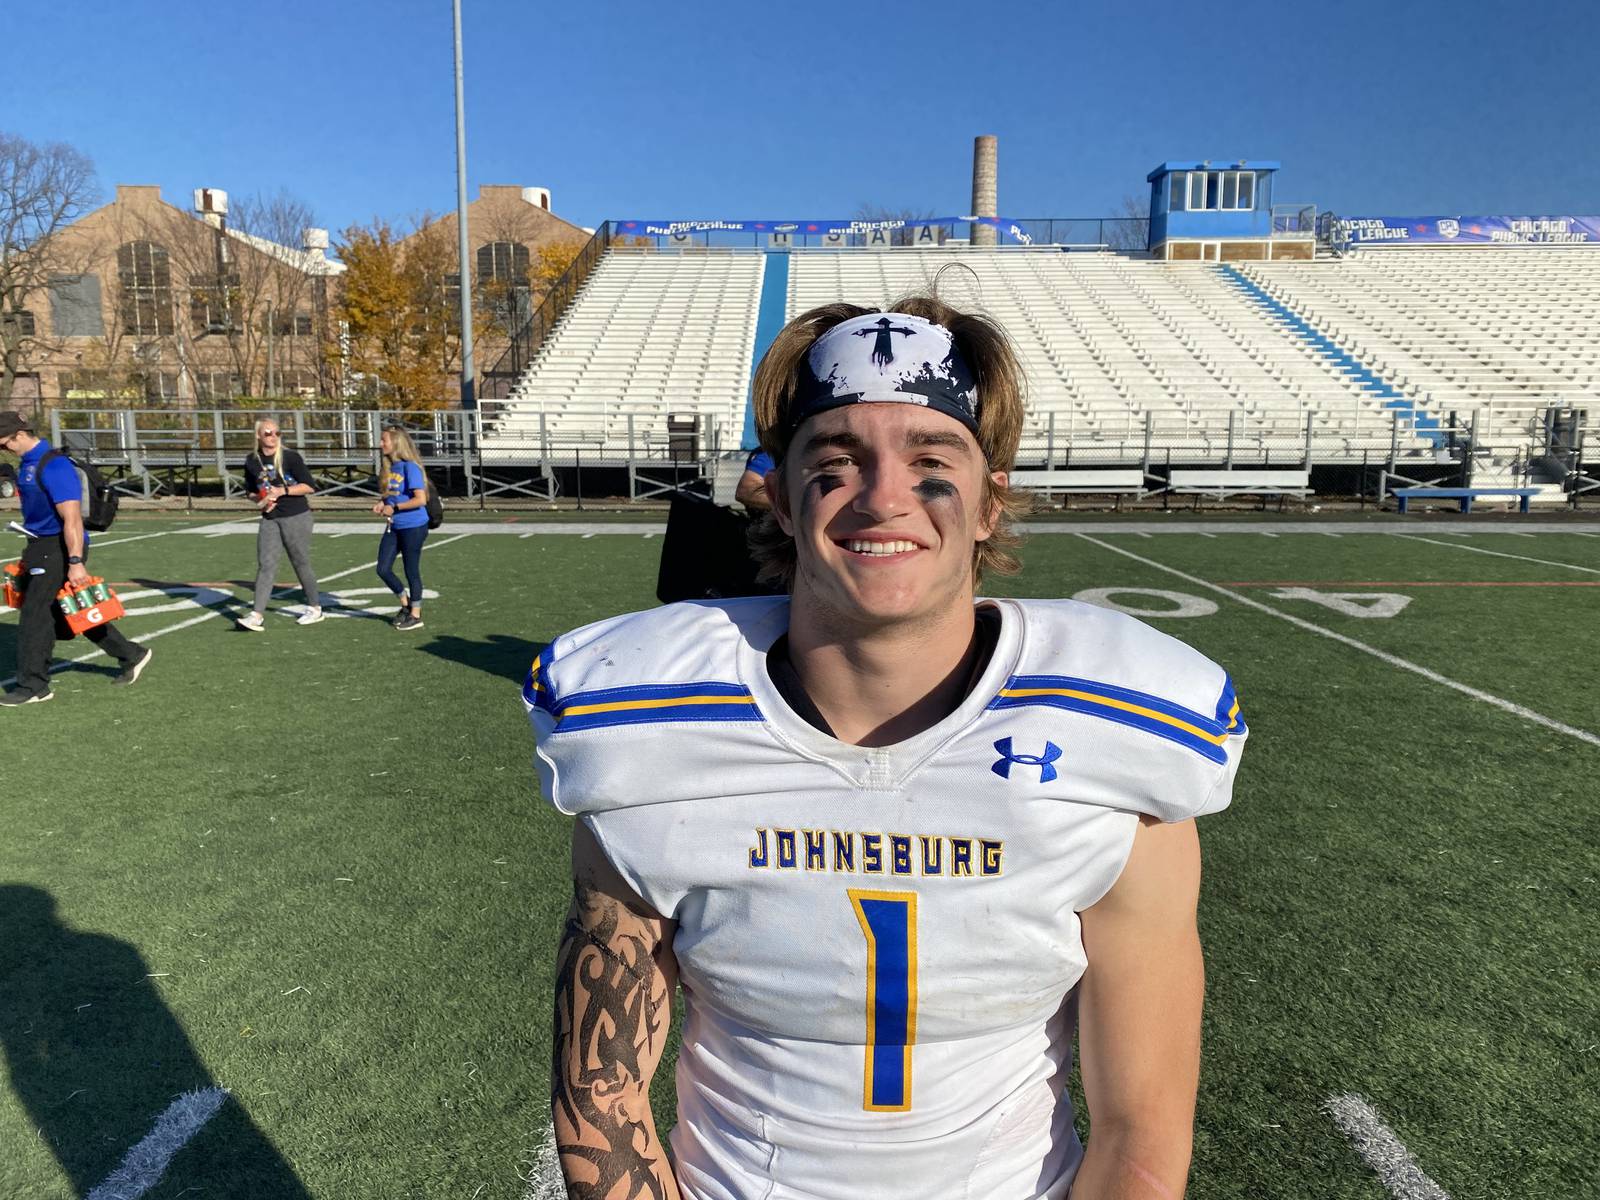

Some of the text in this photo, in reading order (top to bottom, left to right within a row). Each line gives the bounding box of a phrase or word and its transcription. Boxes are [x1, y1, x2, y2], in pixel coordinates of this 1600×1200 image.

[1358, 227, 1409, 242] LEAGUE
[1511, 219, 1567, 233] CHICAGO
[86, 607, 104, 624] G
[748, 828, 1005, 877] JOHNSBURG
[846, 888, 918, 1112] 1
